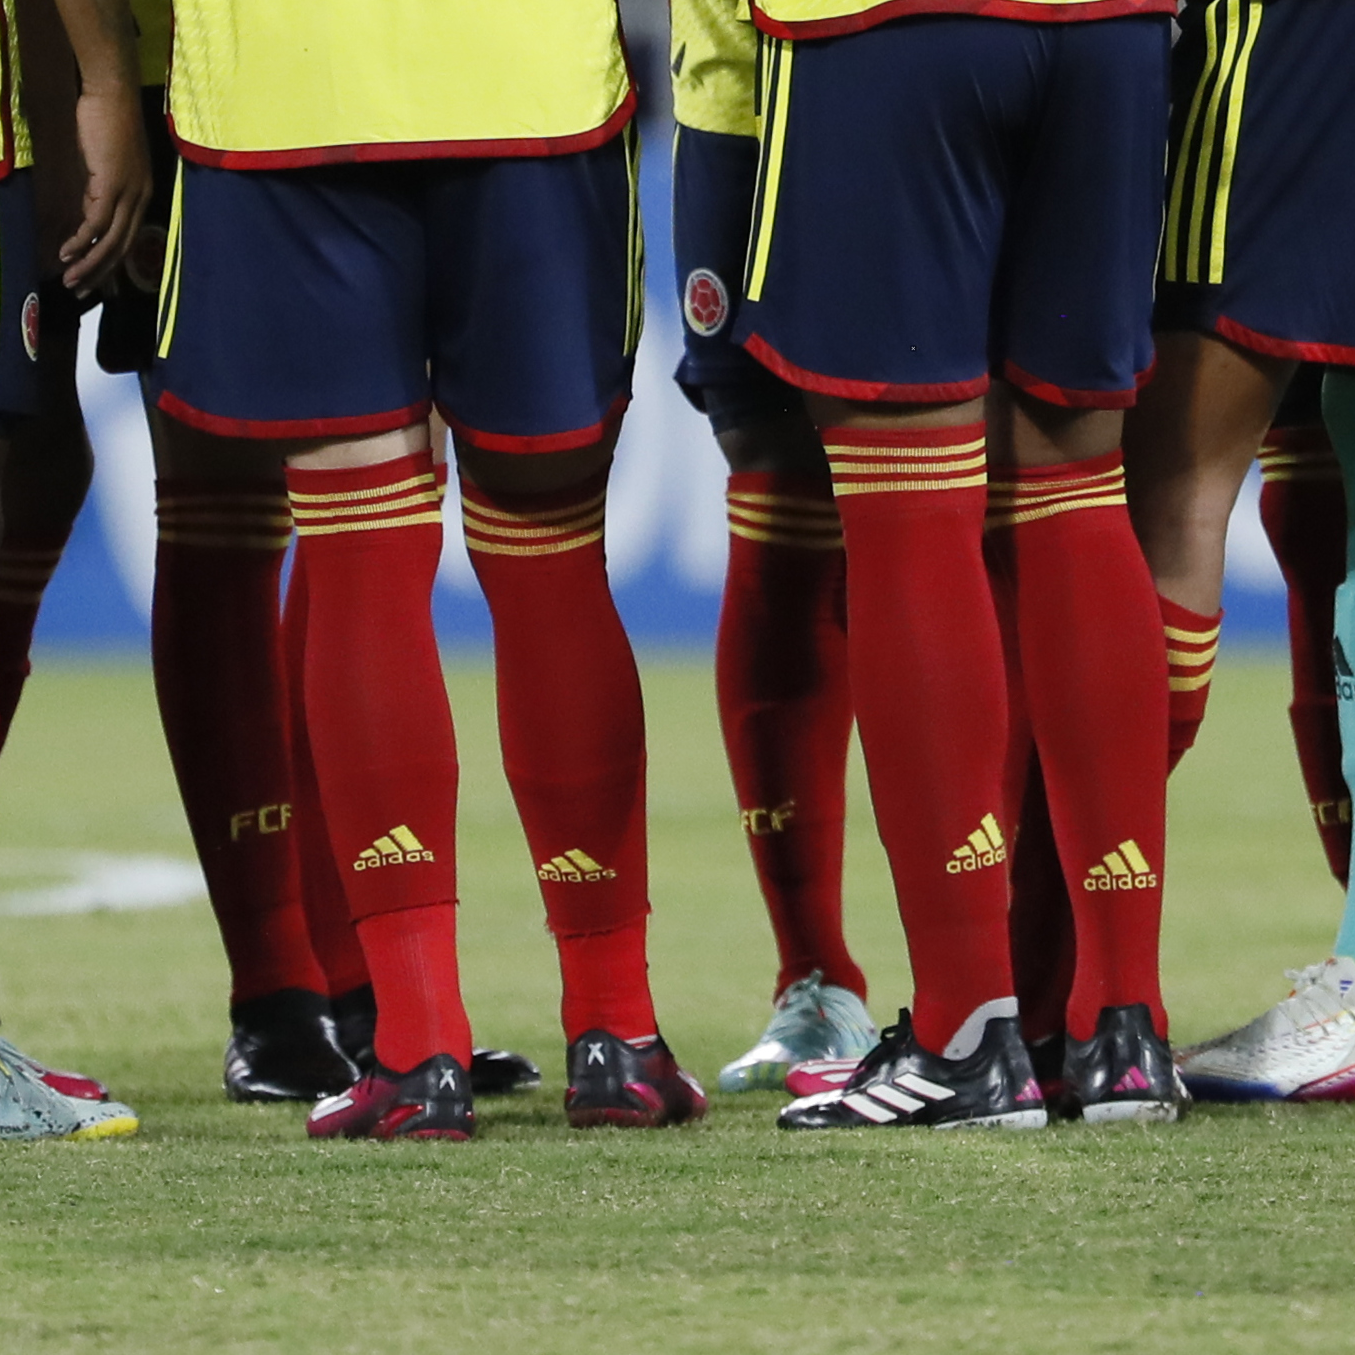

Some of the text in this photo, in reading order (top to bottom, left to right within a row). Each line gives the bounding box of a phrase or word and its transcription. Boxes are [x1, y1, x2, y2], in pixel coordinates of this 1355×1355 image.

[352, 849, 435, 872] adidas
[537, 867, 618, 883] adidas
[1083, 873, 1157, 892] adidas
